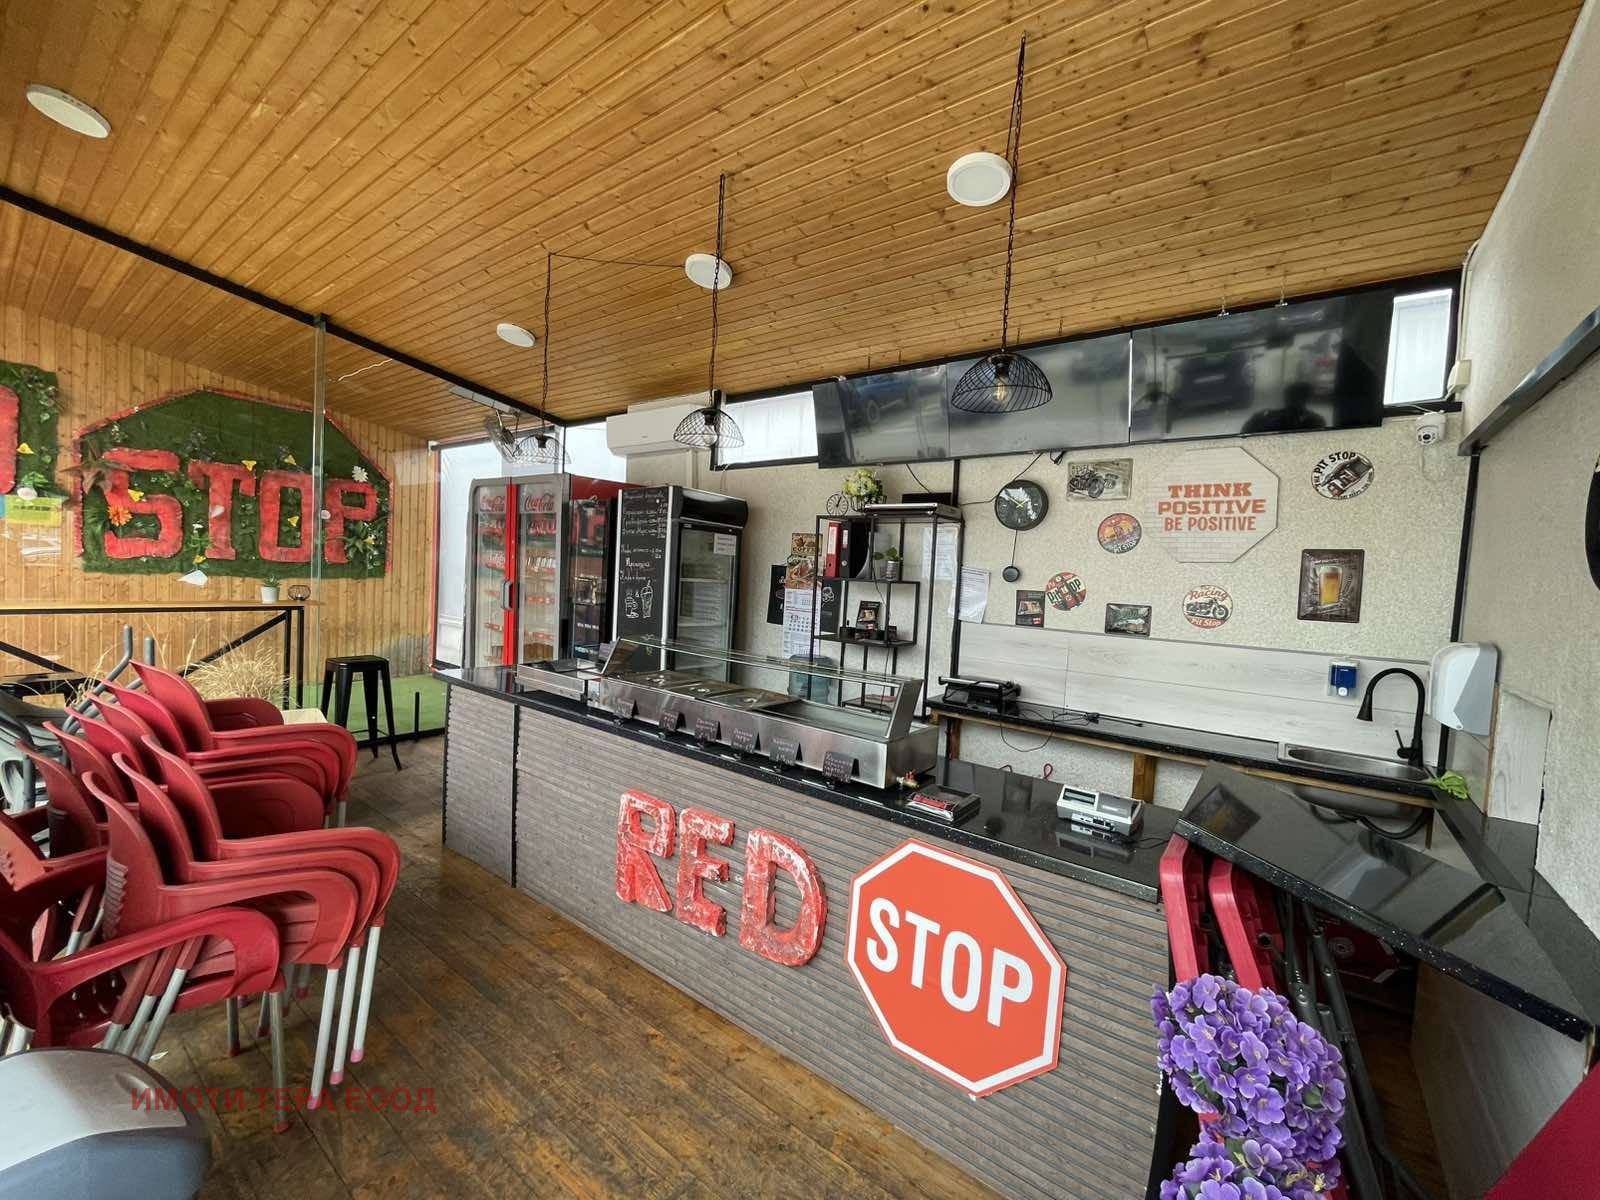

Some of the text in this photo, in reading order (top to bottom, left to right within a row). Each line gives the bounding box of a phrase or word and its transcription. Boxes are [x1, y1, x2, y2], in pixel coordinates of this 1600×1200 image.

[1314, 459, 1328, 474] PIT
[1329, 451, 1356, 463] STOP
[1168, 482, 1252, 498] THINK
[102, 447, 378, 564] STOP
[1158, 499, 1266, 515] POSITIVE
[1165, 516, 1256, 531] BE POSITIVE
[1188, 590, 1229, 602] Racing
[616, 788, 827, 967] RED
[866, 897, 1034, 1028] STOP
